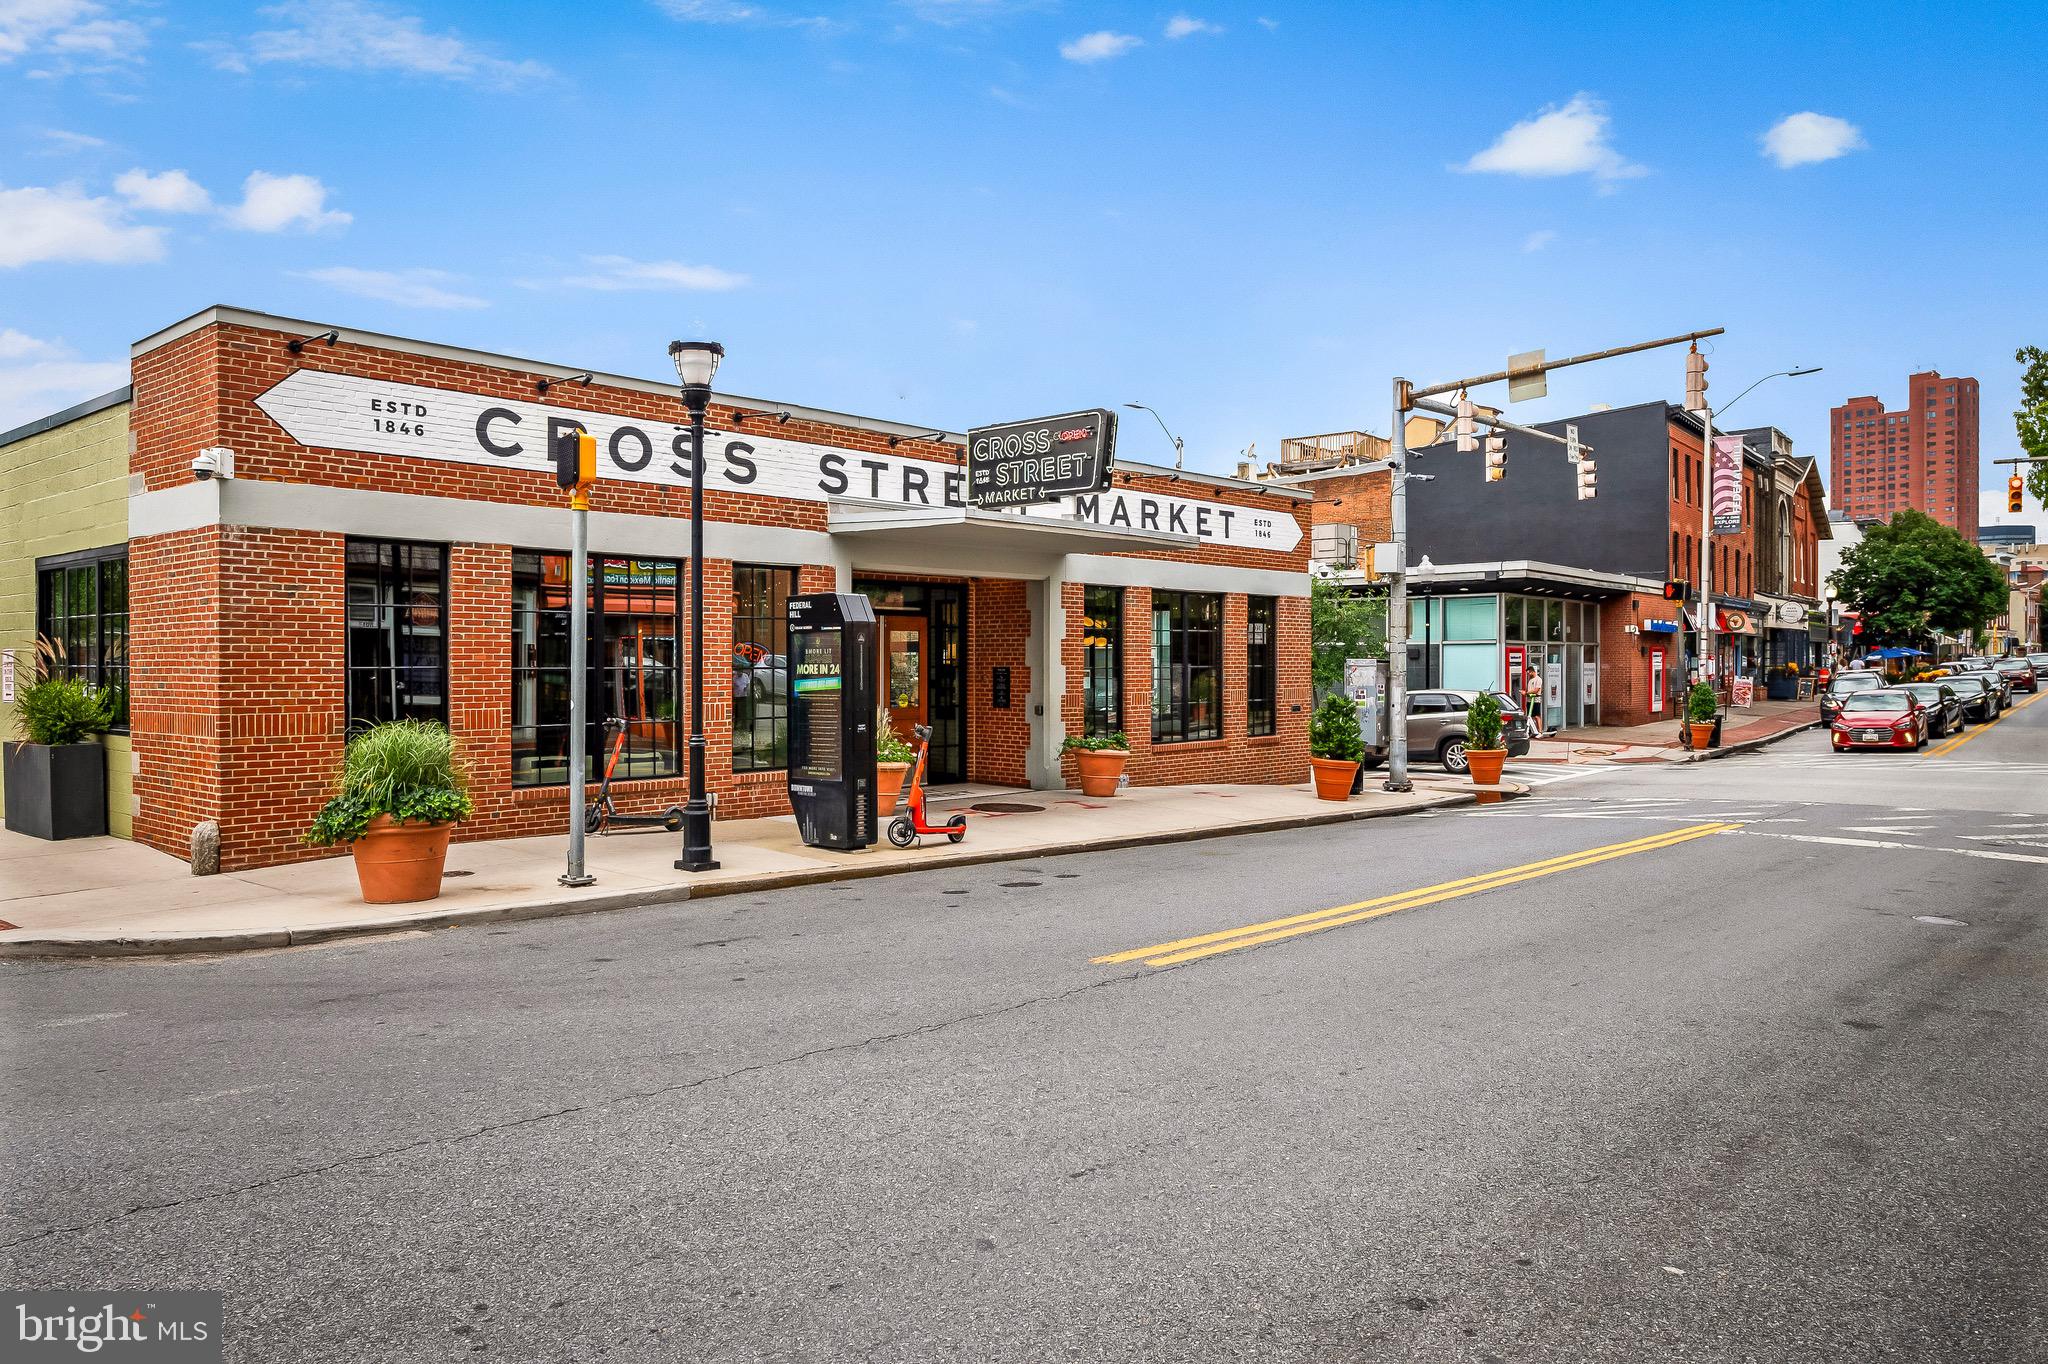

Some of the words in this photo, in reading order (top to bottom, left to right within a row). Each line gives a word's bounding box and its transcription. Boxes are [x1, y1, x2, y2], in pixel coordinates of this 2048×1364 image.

[371, 398, 427, 417] ESTD
[373, 418, 424, 437] 1846
[973, 428, 1050, 462] CROSS
[975, 469, 990, 477] ESTD
[995, 452, 1089, 486] STREET
[984, 487, 1036, 504] MARKET
[1077, 494, 1235, 539] MARKET
[1254, 518, 1272, 528] ESTD
[1255, 529, 1272, 539] 1846
[789, 601, 812, 610] FEDERAL
[789, 611, 801, 619] HILL
[734, 642, 768, 664] OPEN
[796, 664, 818, 675] MORE
[819, 664, 829, 674] IN
[830, 663, 840, 674] 24
